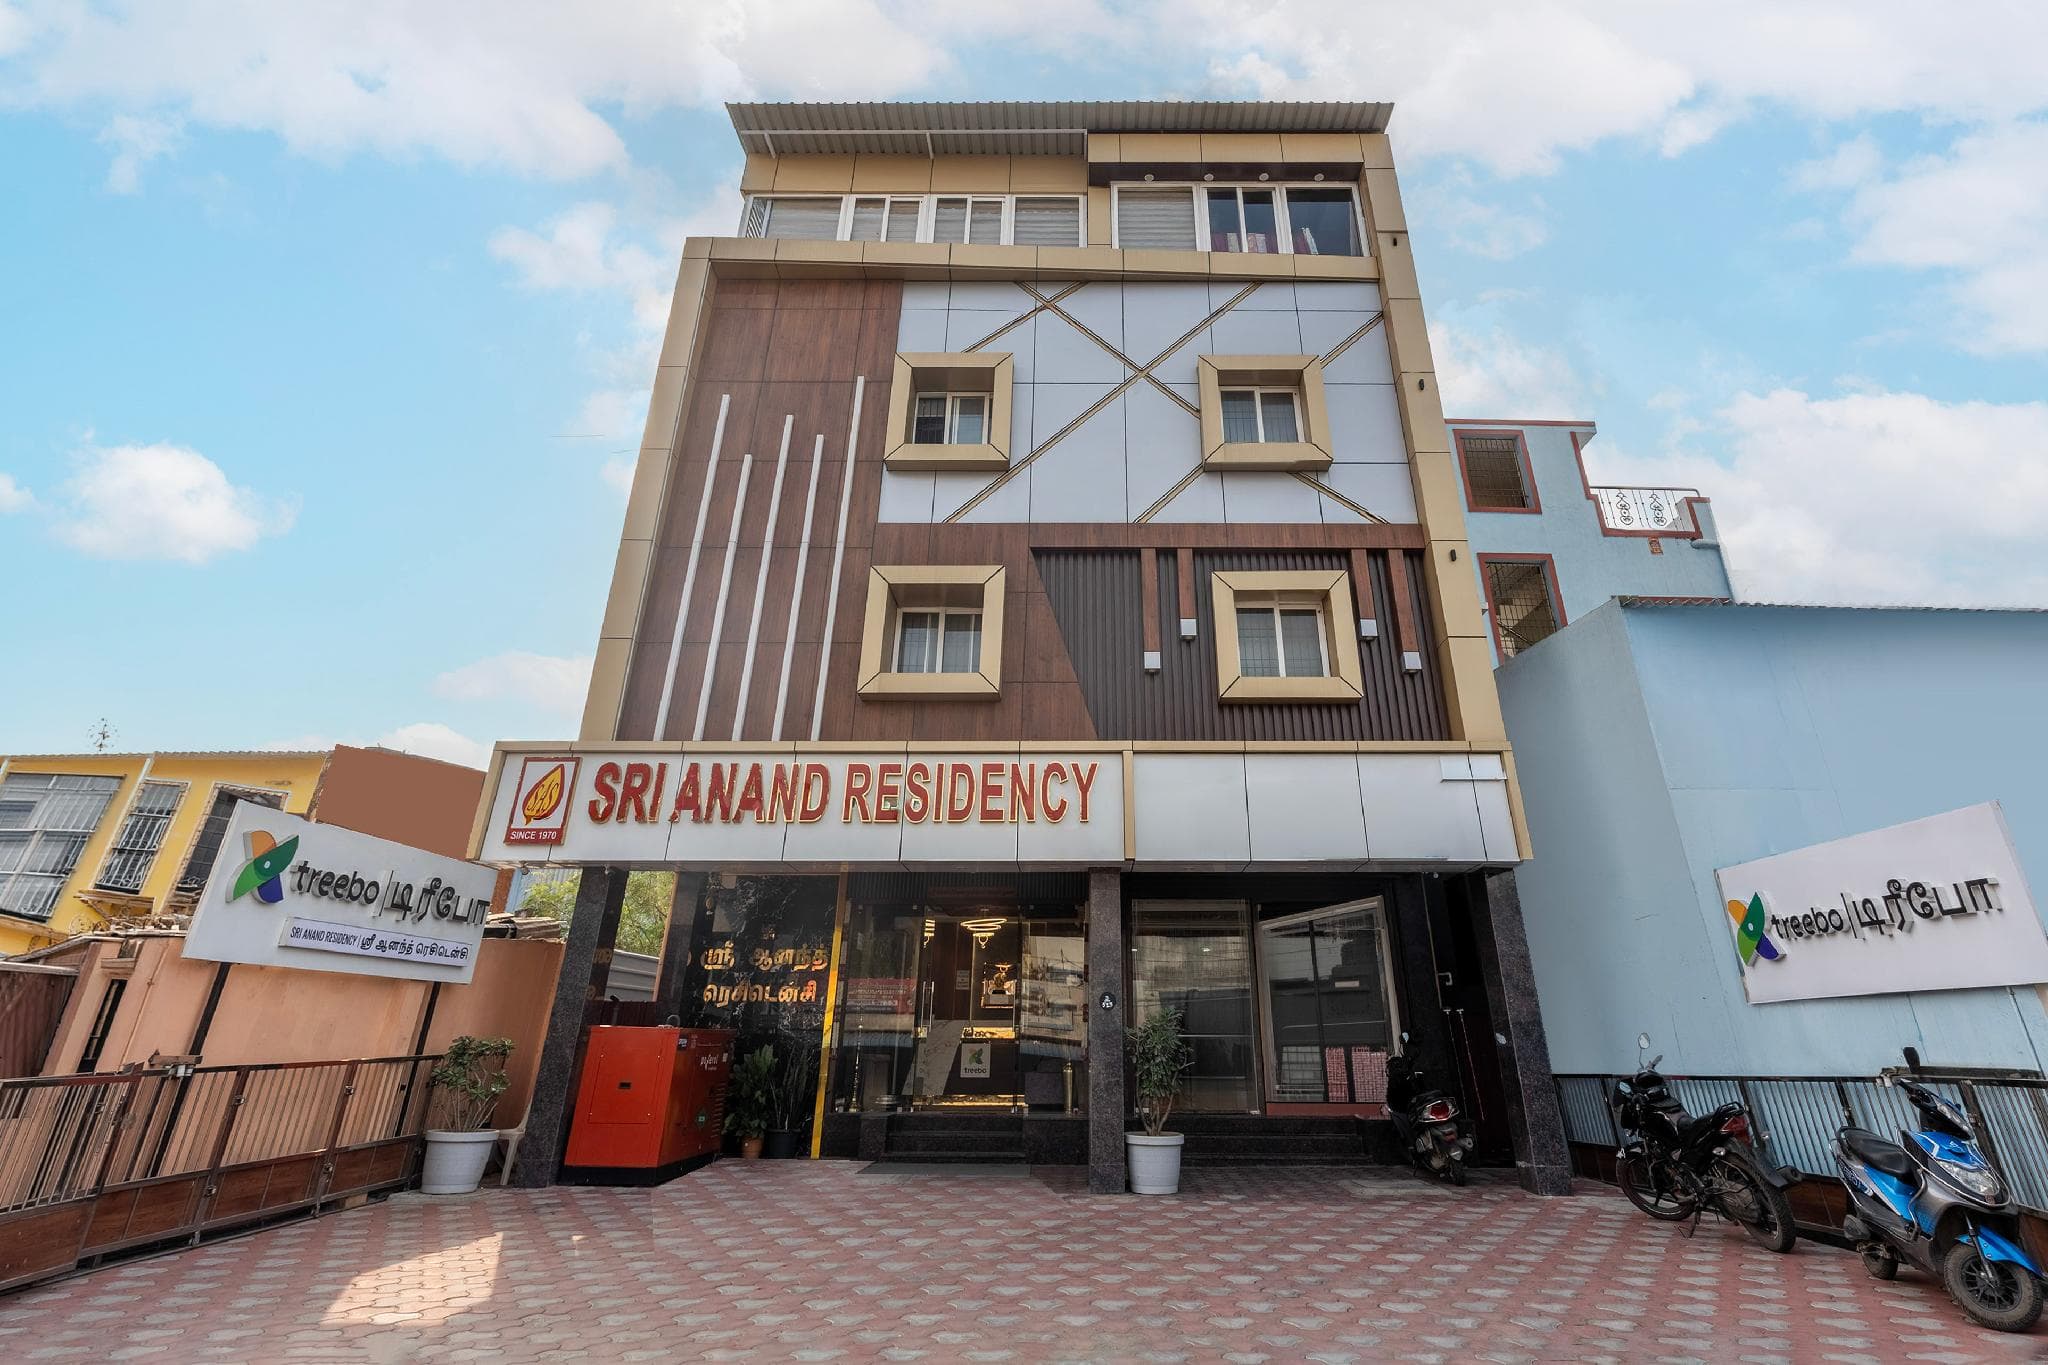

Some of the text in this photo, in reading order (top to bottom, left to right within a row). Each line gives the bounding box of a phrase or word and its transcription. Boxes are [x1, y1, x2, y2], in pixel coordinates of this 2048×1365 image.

[588, 761, 1099, 824] SRI ANAND RESIDENCY
[510, 831, 557, 840] SINCE 1970
[293, 861, 380, 905] treebo
[389, 877, 490, 925] டிரீபோ
[1852, 878, 1996, 935] டிரீபோ
[290, 926, 358, 946] SRI ANAND RESIDENCY
[1771, 907, 1845, 940] treebo
[375, 939, 414, 955] ஆனந்த்
[416, 943, 469, 960] ரெசிடென்சி
[964, 1066, 987, 1075] treebo
